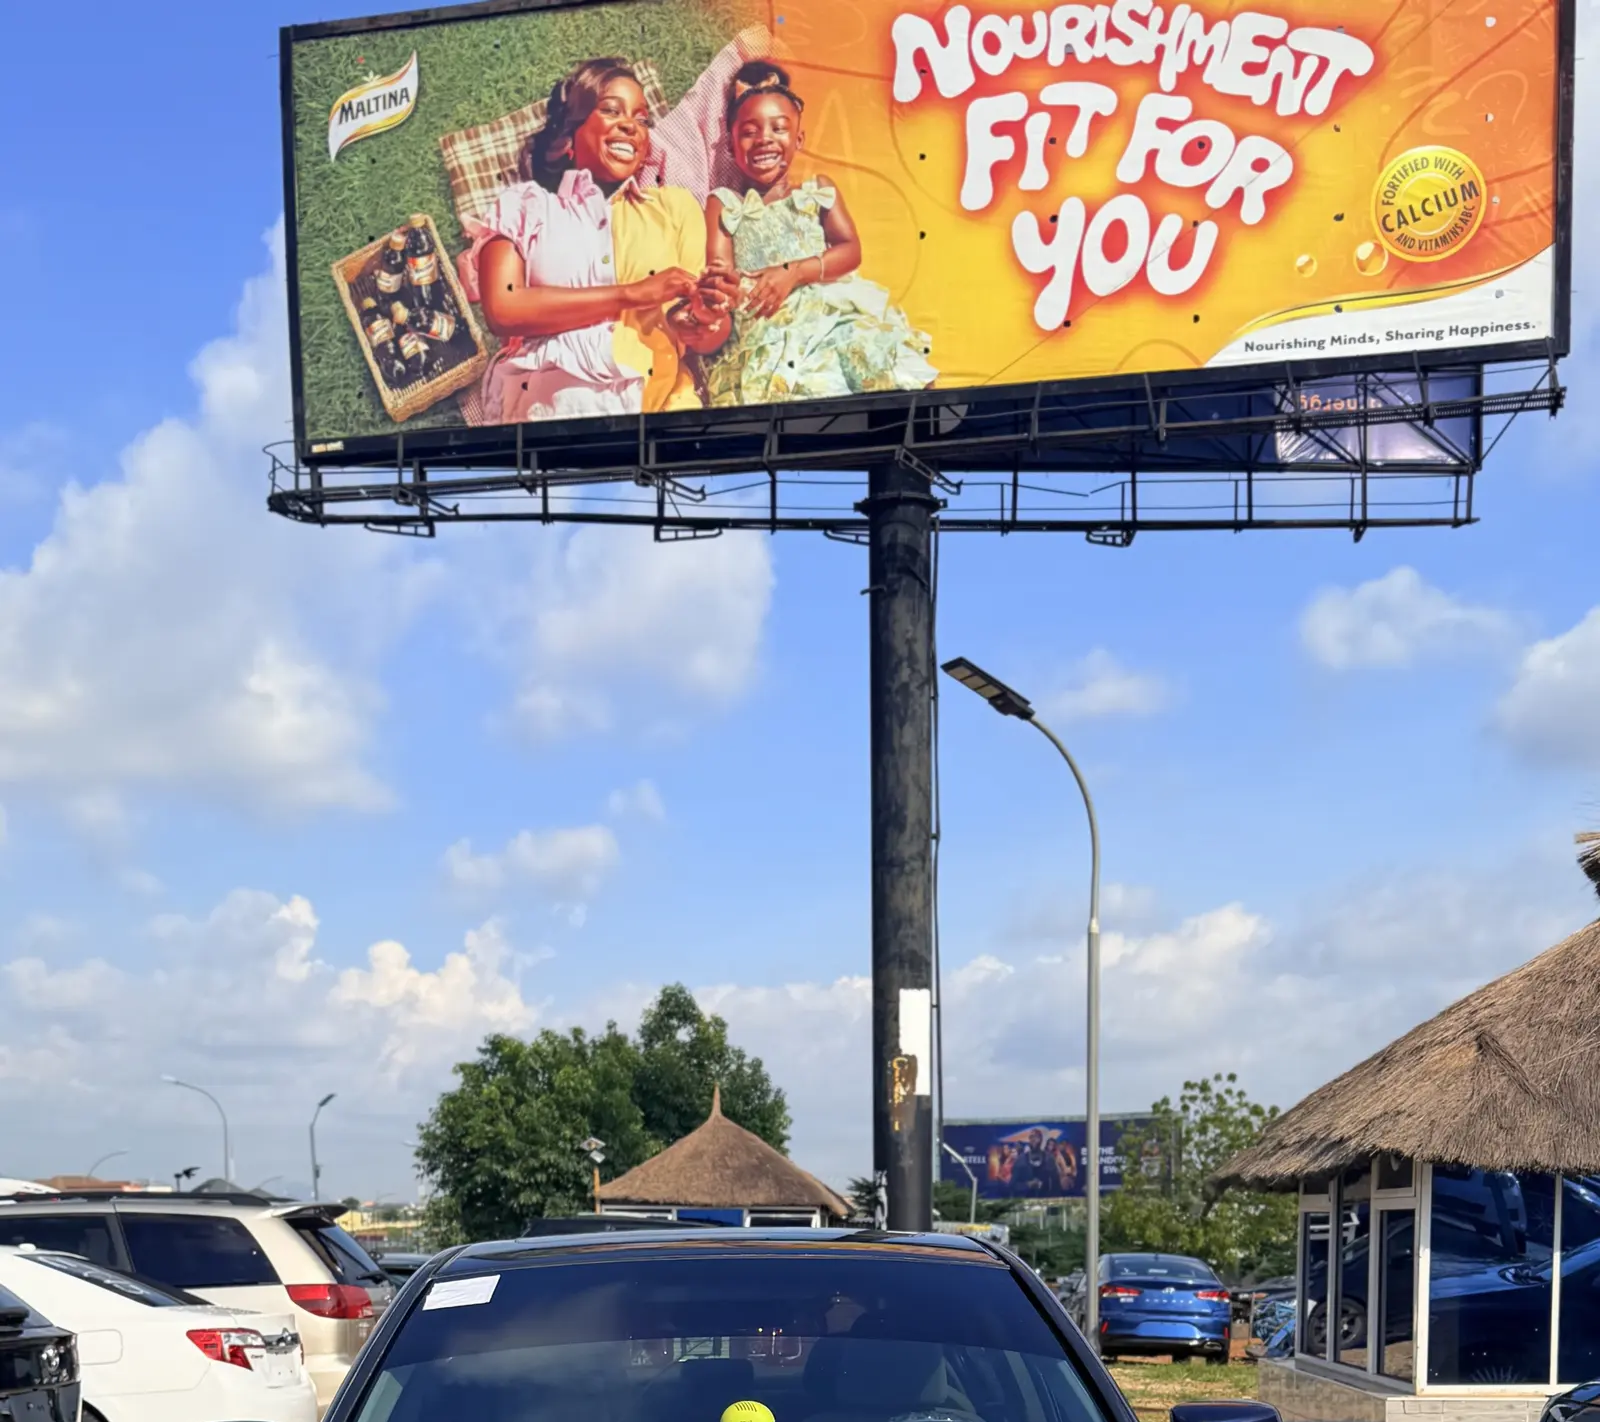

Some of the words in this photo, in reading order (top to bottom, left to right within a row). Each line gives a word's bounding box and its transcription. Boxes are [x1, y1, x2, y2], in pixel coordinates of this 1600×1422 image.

[891, 0, 1374, 116] NOURISHMENT
[339, 87, 410, 125] MALTINA
[960, 81, 1118, 211] FIT
[1116, 92, 1293, 225] FOR
[1382, 157, 1429, 206] FORTIFIED
[1434, 156, 1465, 180] WITH
[1382, 180, 1479, 233] CALCIUM
[1395, 233, 1416, 250] AND
[1418, 223, 1464, 251] VITAMINS
[1459, 205, 1475, 226] ABC
[1012, 194, 1218, 331] YOU
[1244, 338, 1326, 352] Nourishing
[1330, 333, 1381, 346] Minds,
[1385, 327, 1445, 342] Sharing
[1449, 321, 1536, 338] Happiness.
